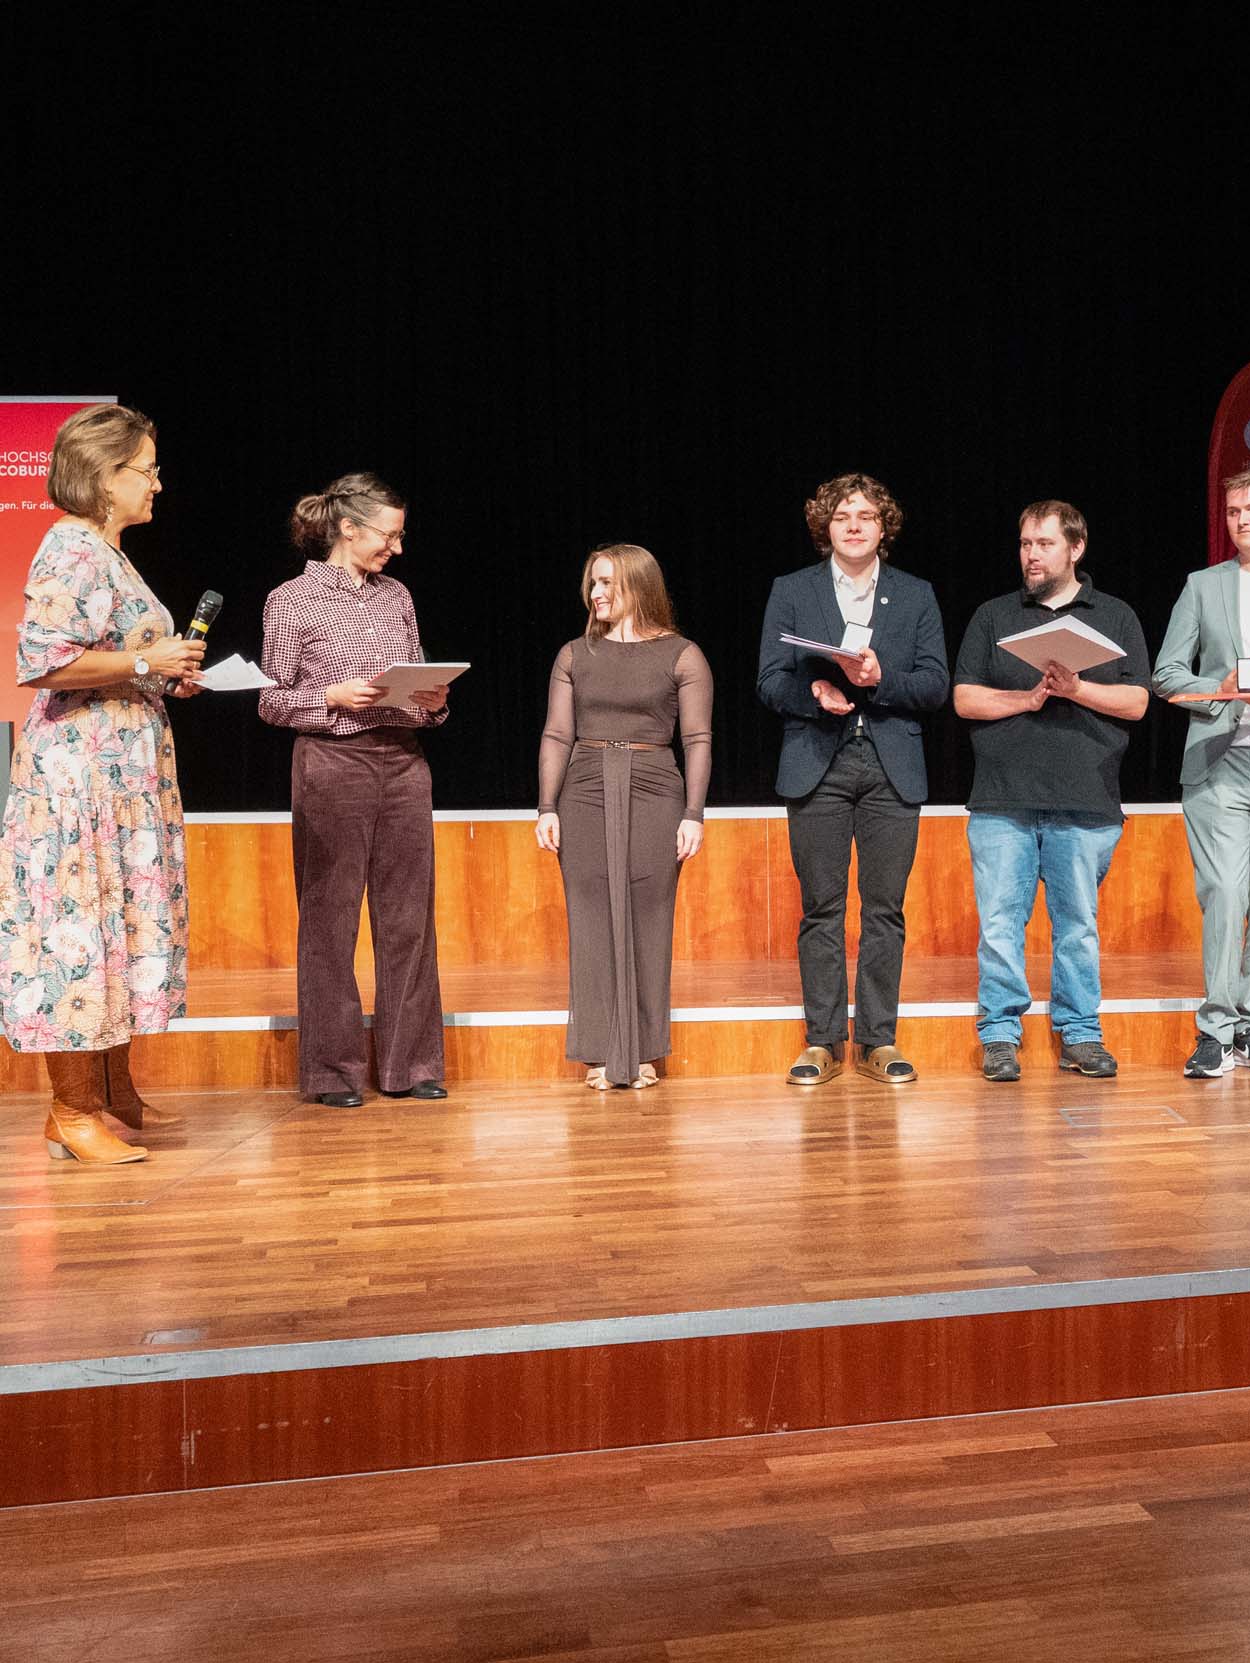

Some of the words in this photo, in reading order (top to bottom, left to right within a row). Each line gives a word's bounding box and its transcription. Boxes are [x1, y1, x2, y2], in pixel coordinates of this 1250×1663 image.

[0, 465, 50, 476] COBUR
[22, 501, 37, 510] Für
[40, 501, 55, 510] die
